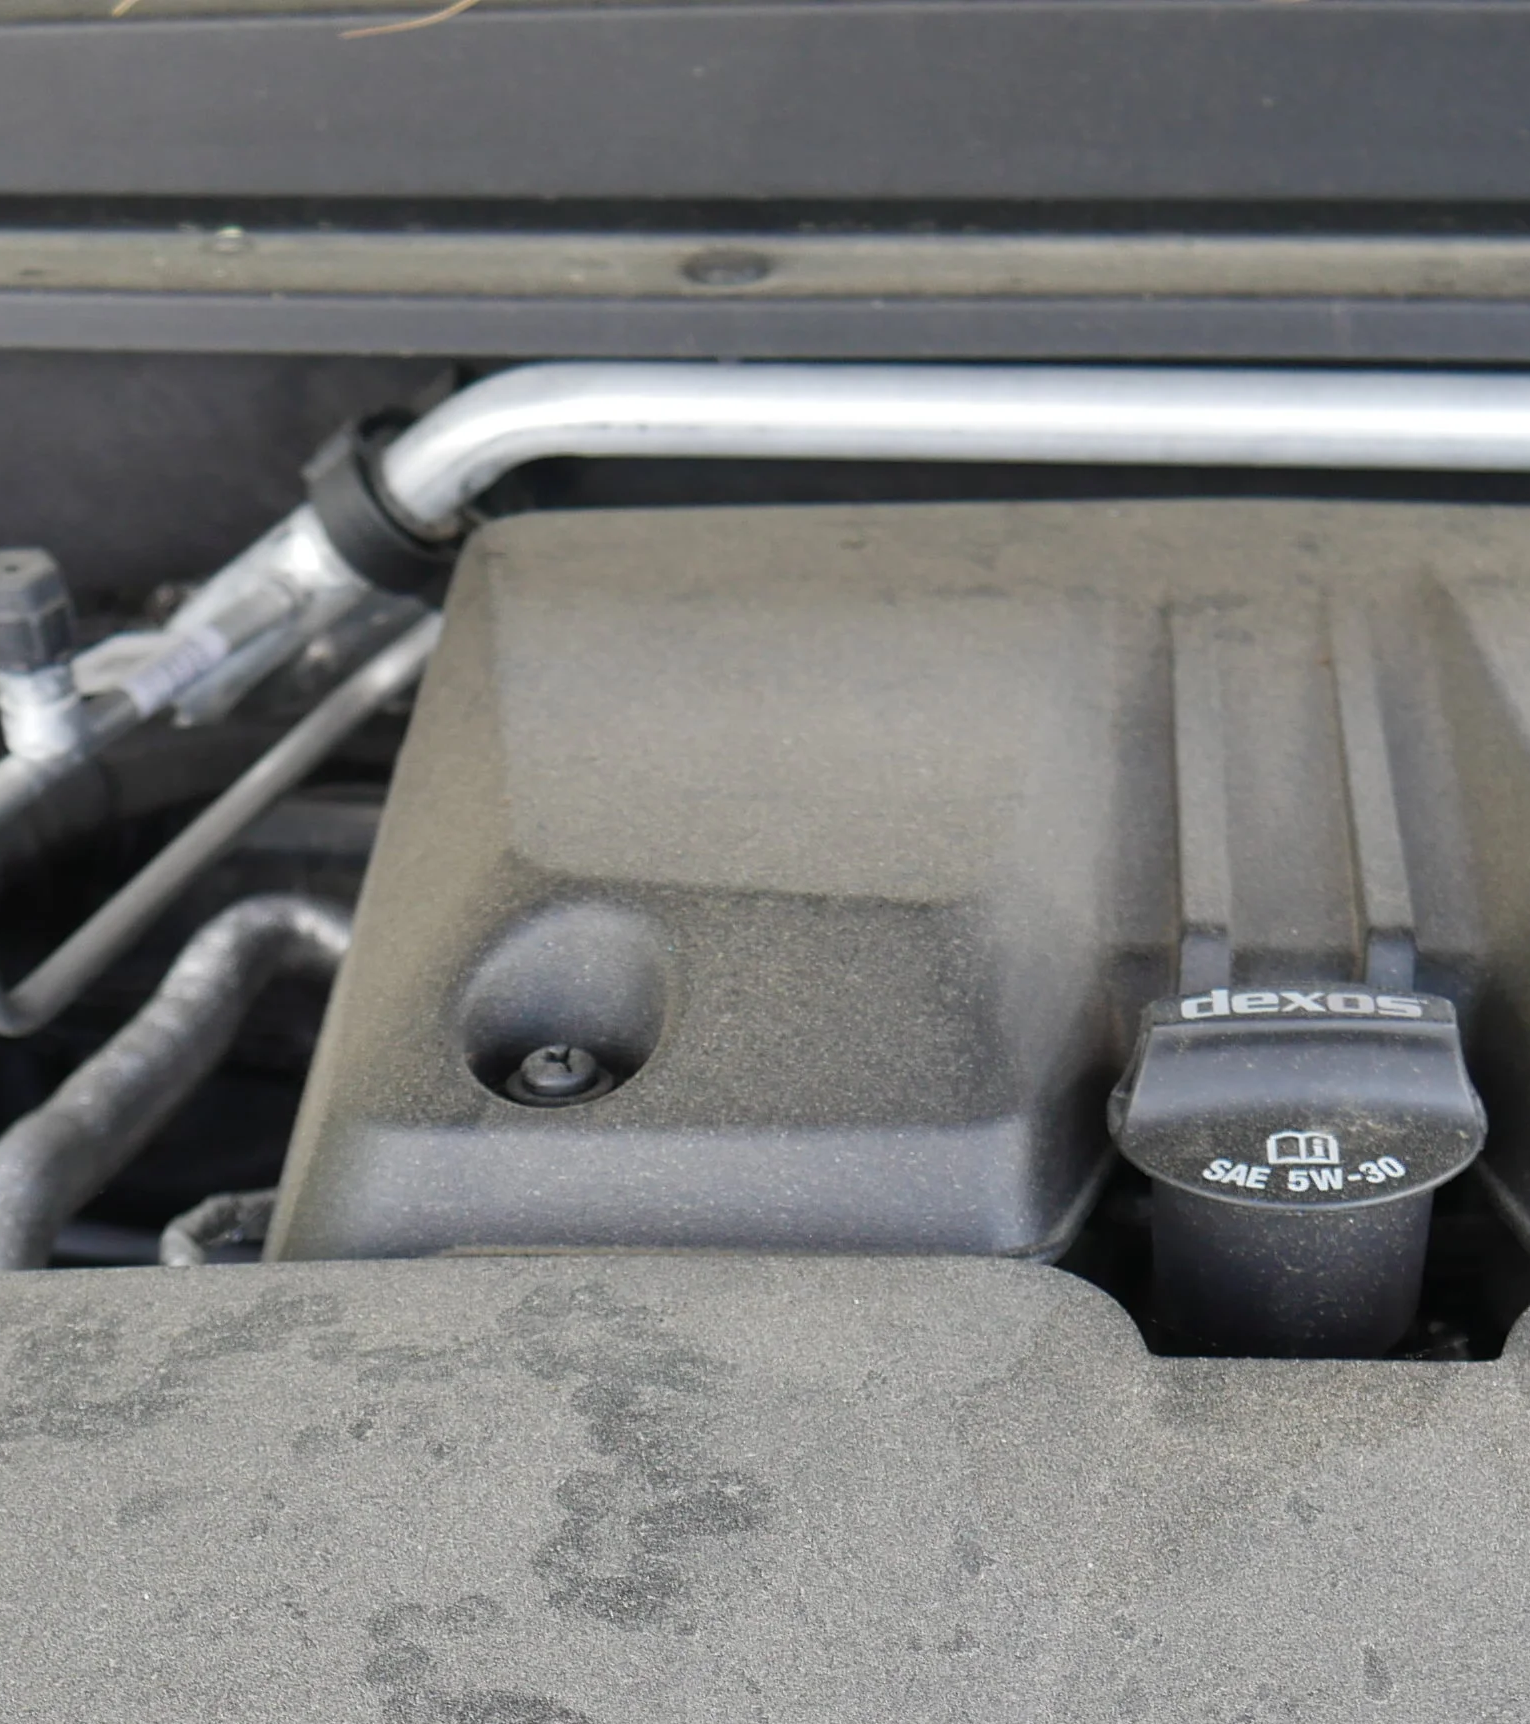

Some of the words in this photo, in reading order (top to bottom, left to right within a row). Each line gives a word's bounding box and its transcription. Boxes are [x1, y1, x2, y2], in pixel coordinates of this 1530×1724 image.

[1180, 989, 1424, 1020] dexos
[1202, 1157, 1271, 1190] SAE
[1287, 1156, 1407, 1193] 5W-30
